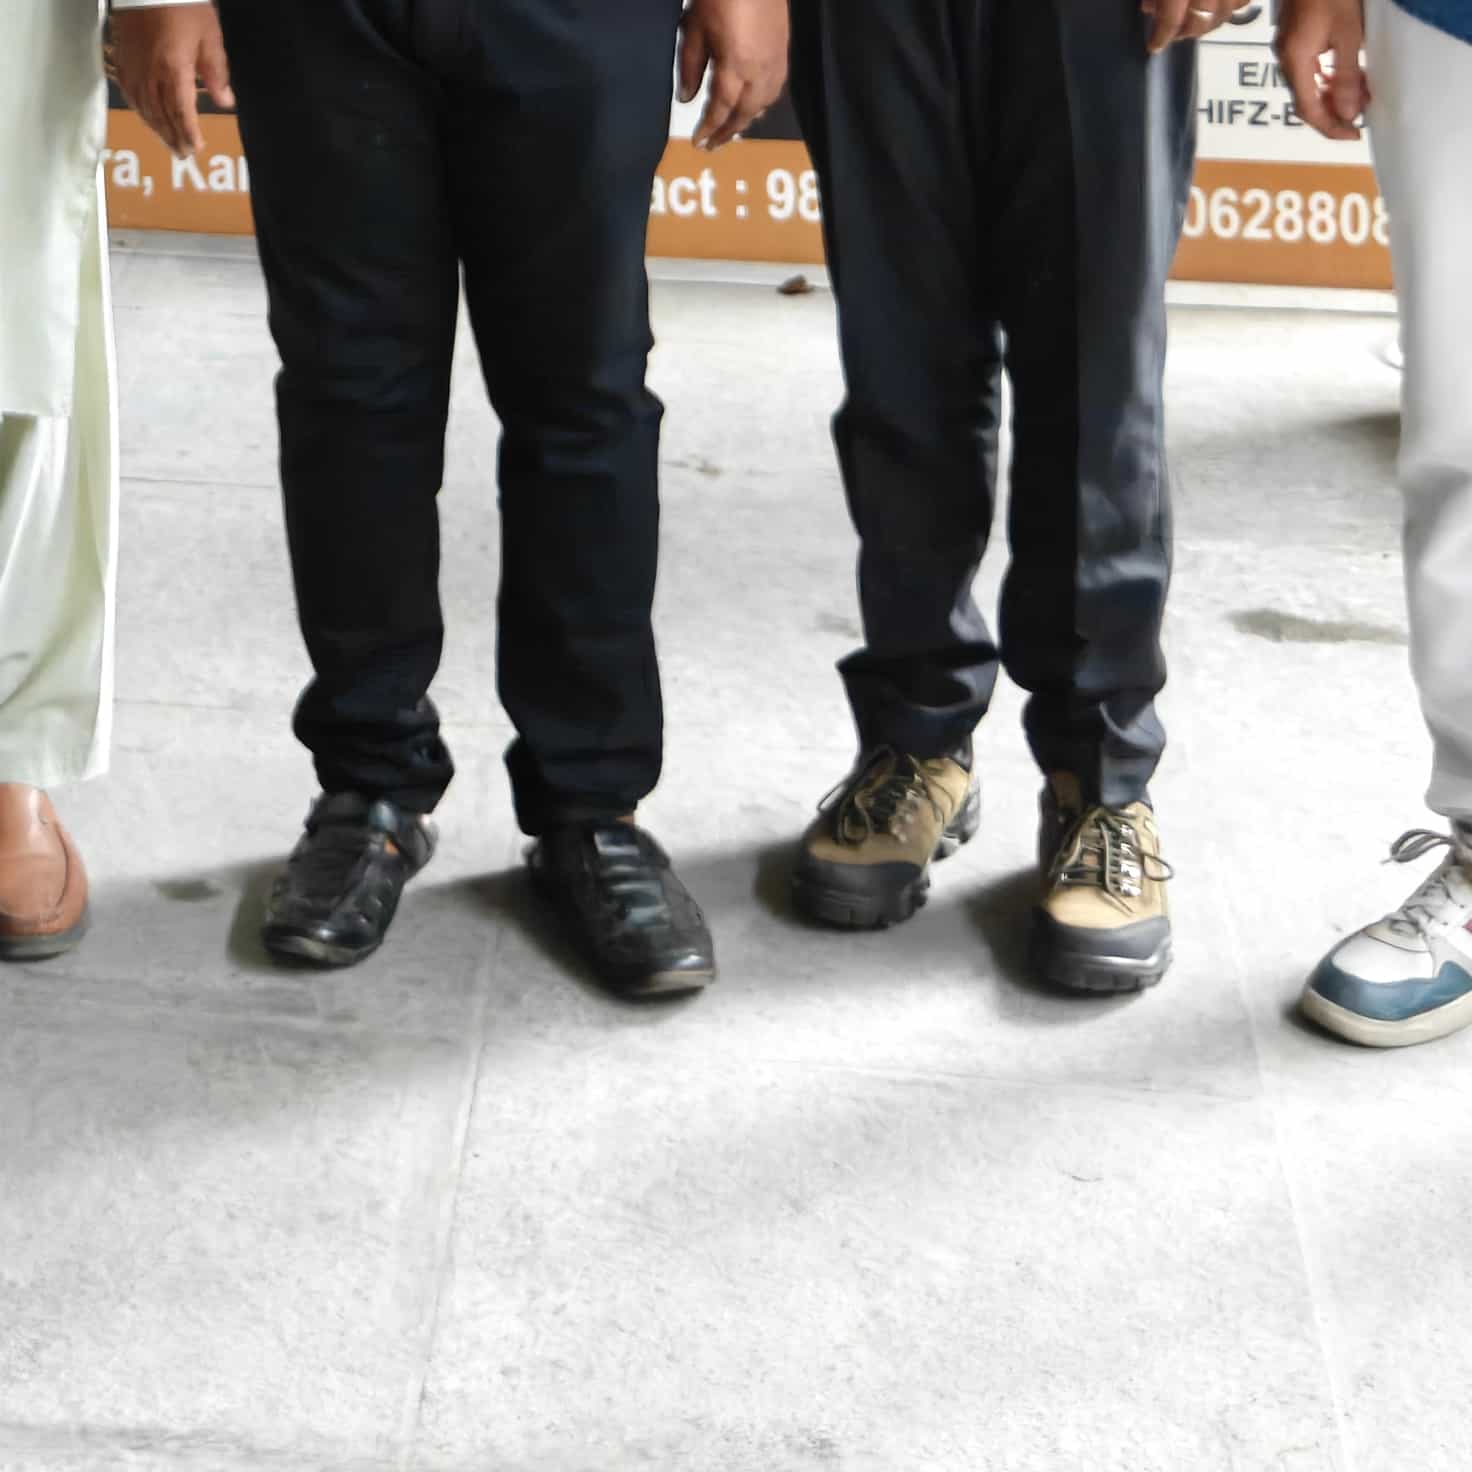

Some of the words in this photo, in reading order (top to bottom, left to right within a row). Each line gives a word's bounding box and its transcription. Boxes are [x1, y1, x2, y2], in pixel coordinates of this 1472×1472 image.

[649, 167, 718, 219] act
[766, 168, 823, 223] 98
[1182, 185, 1391, 247] 0628808
